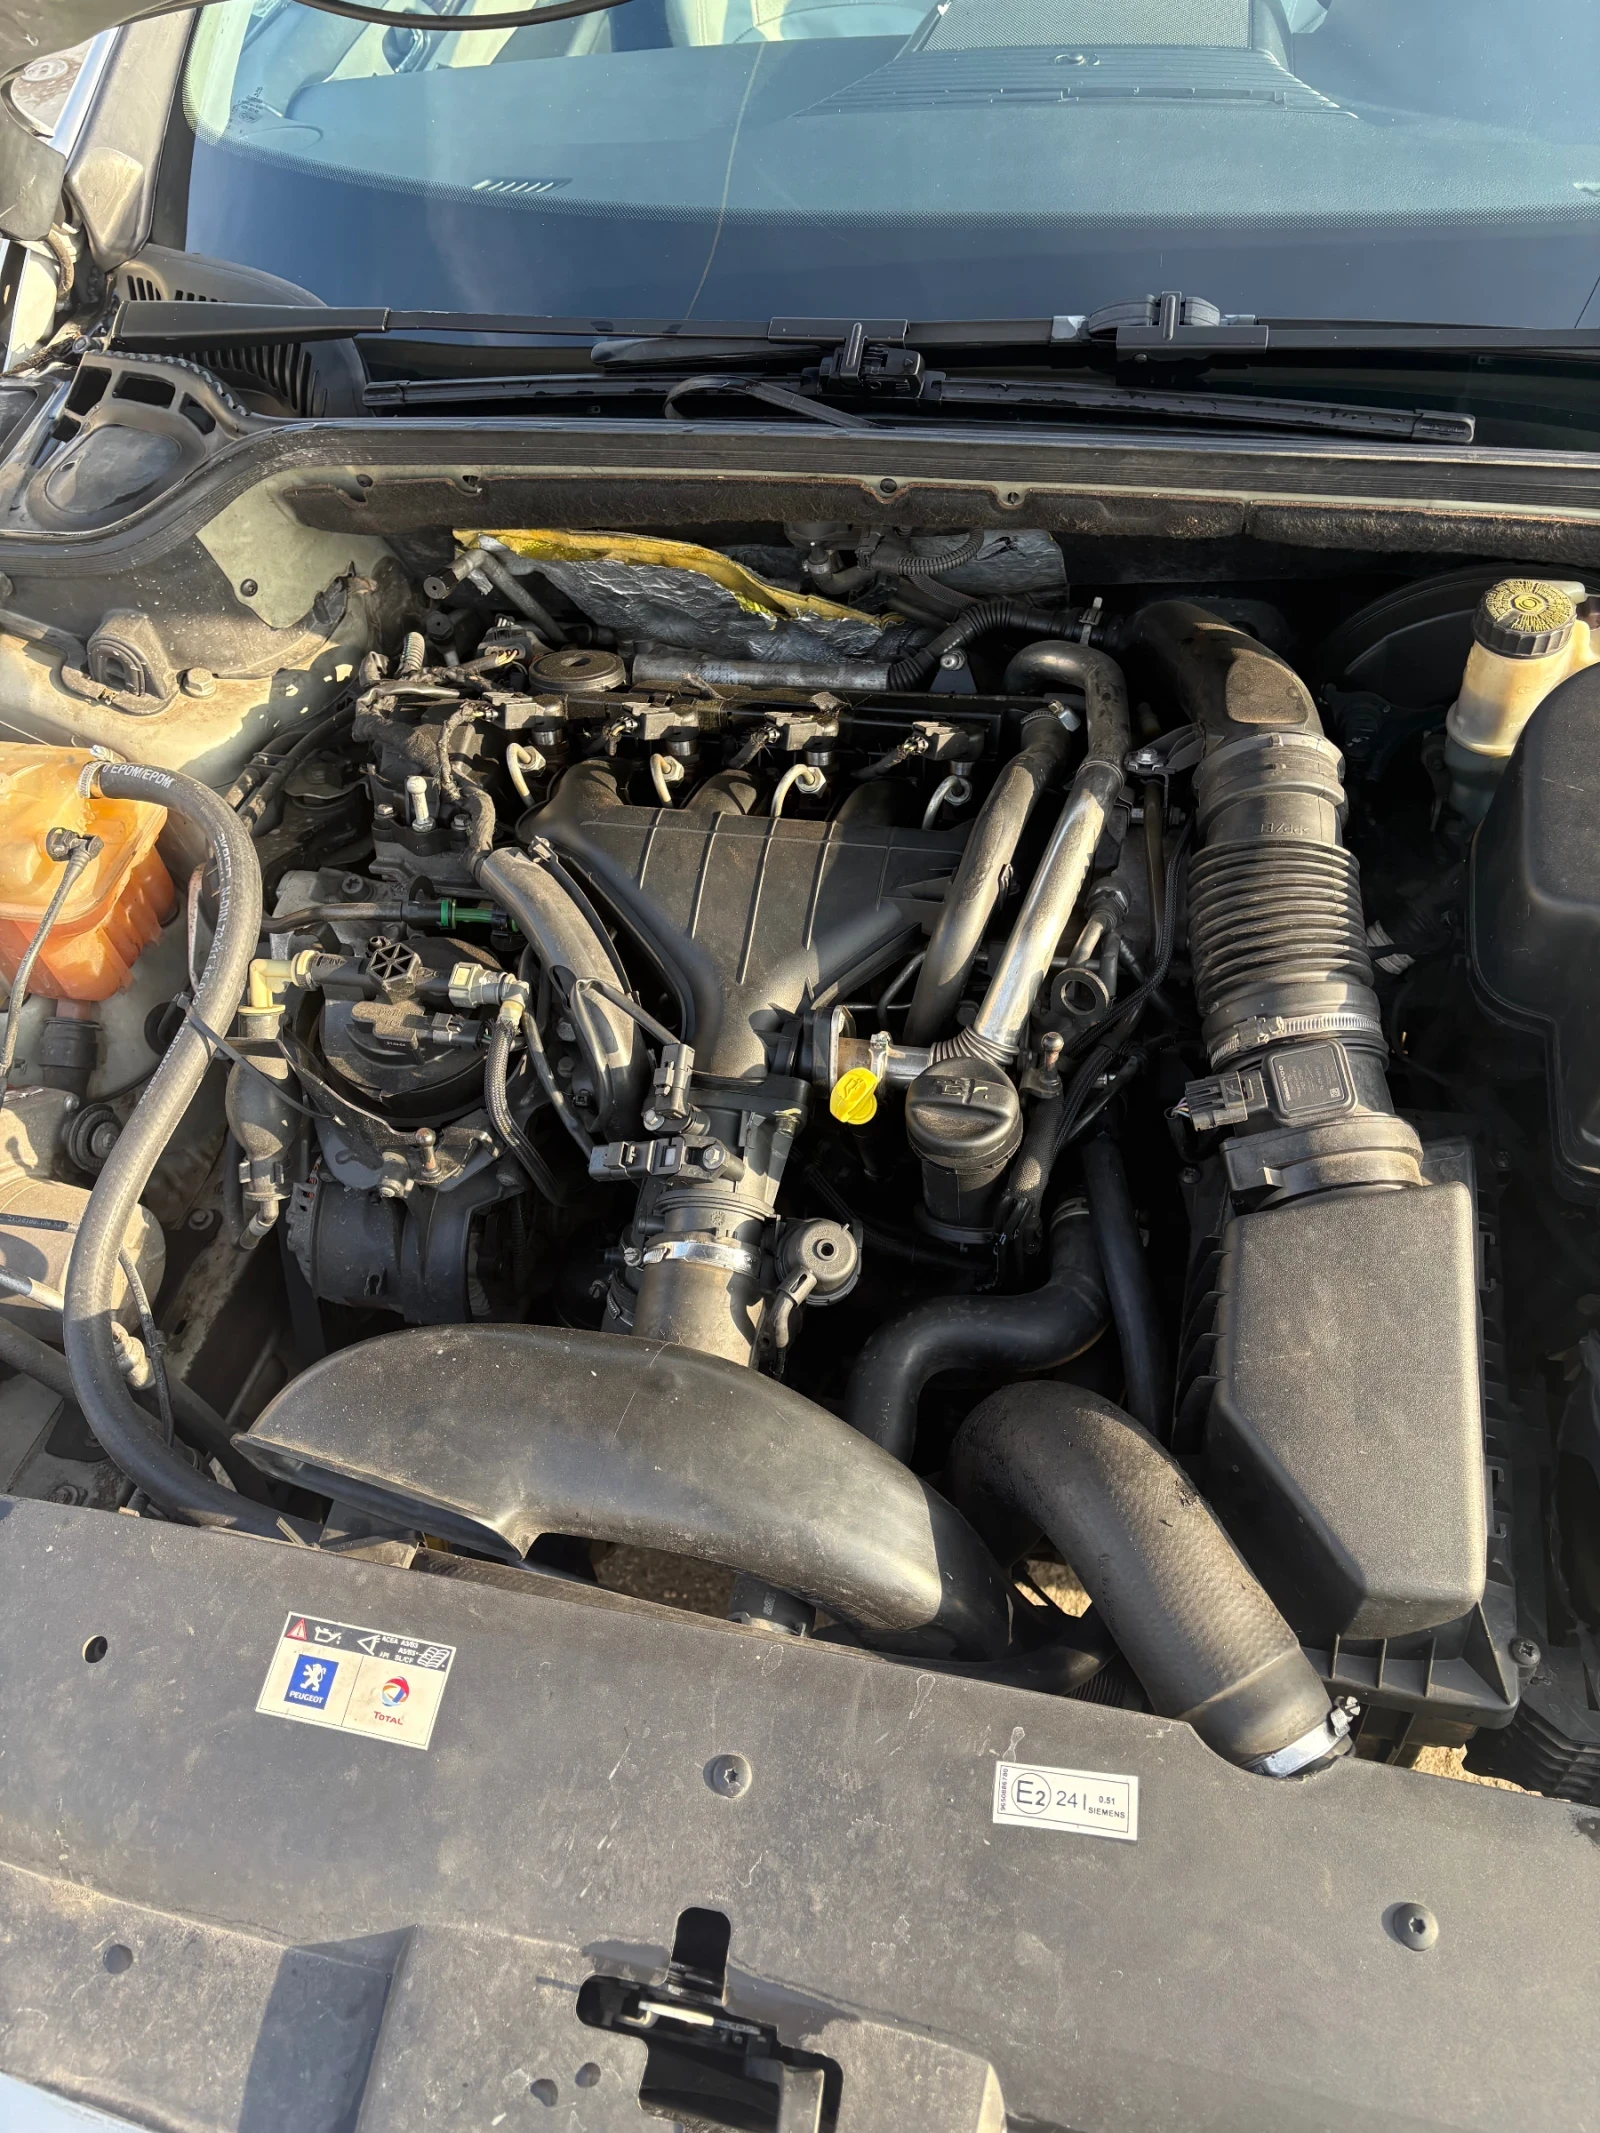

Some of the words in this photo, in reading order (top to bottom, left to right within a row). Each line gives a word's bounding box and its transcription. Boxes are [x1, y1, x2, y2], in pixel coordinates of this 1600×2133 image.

[110, 764, 175, 789] EPDM/EPDM
[289, 1690, 324, 1704] PEUGEOT
[373, 1711, 404, 1725] TOTAL
[1098, 1795, 1116, 1806] 0.51
[1088, 1806, 1126, 1819] SIEMENS
